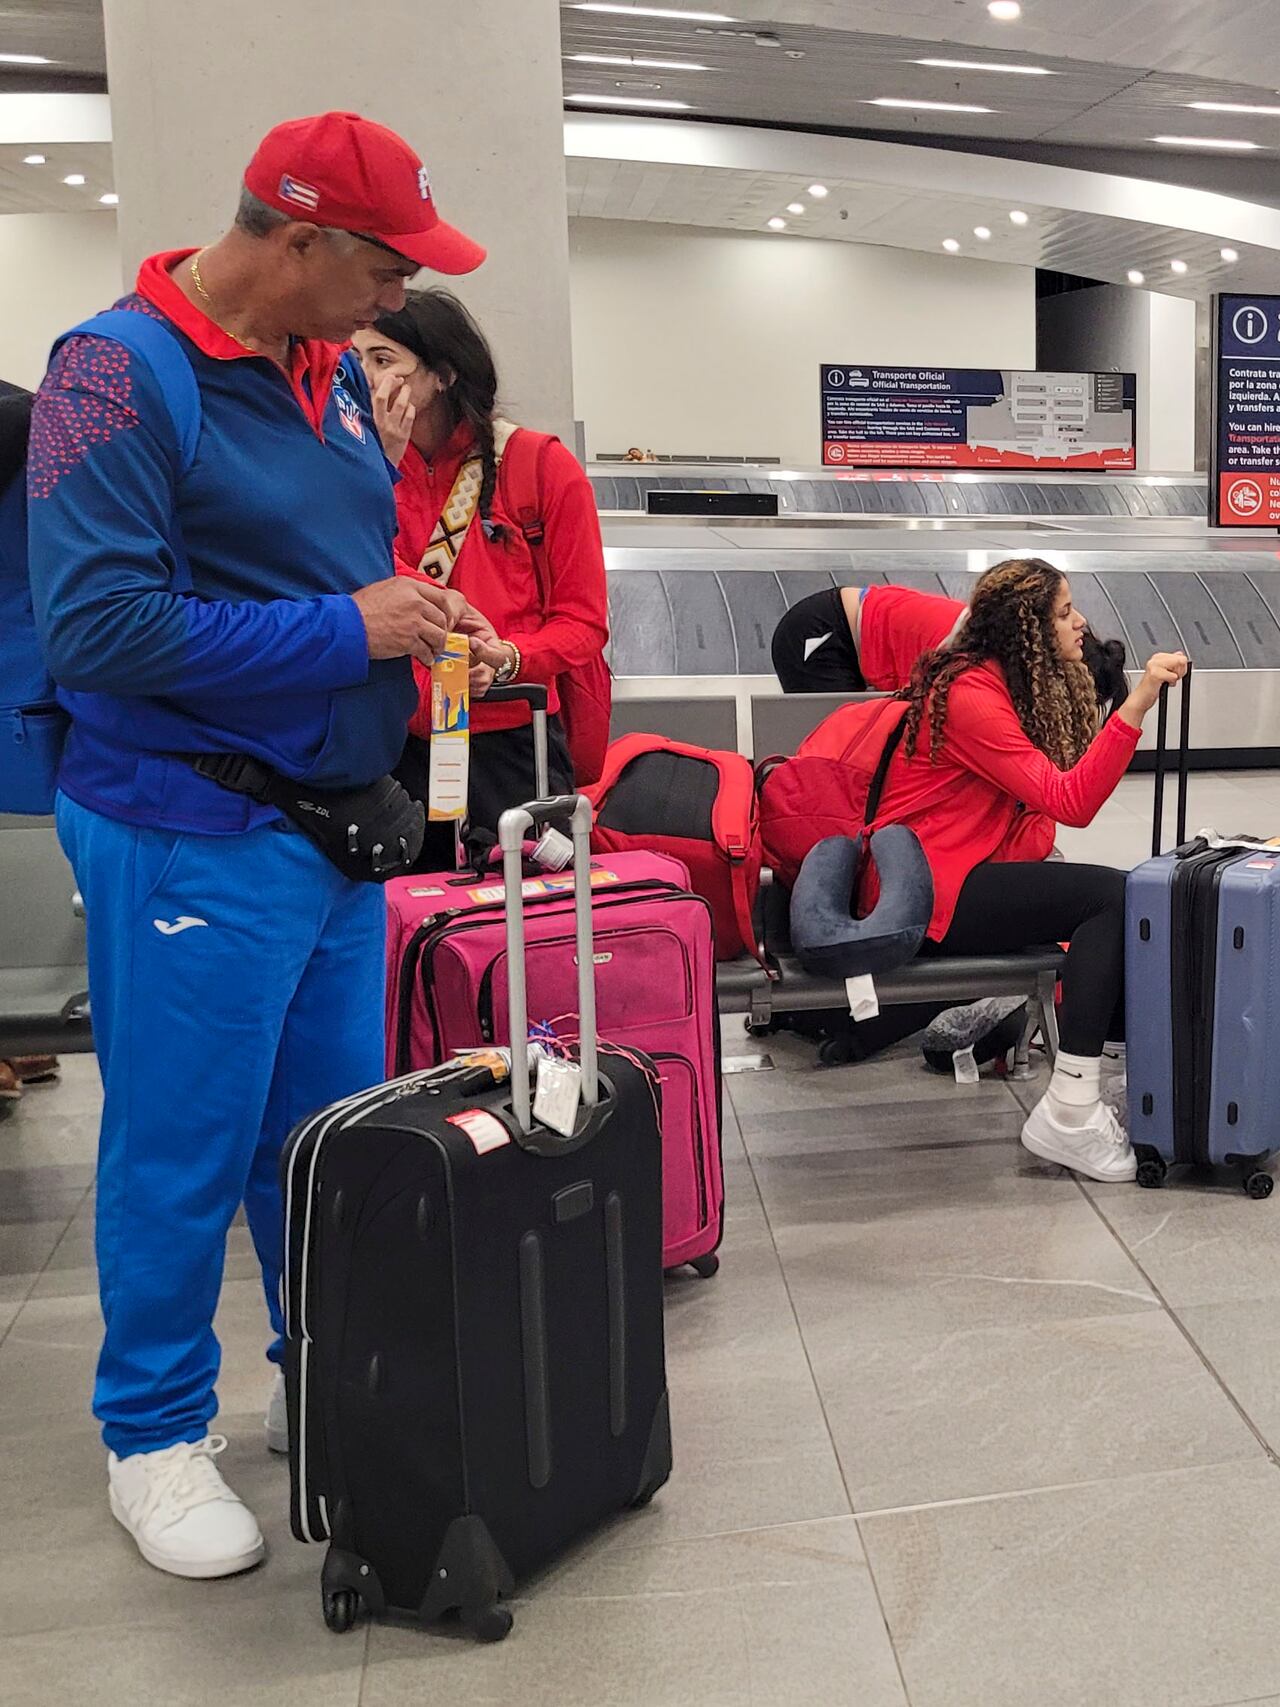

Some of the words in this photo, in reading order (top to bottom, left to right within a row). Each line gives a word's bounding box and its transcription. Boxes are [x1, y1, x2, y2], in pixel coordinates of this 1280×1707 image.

[872, 371, 917, 381] Transporte
[919, 372, 945, 381] Oficial
[1229, 368, 1266, 377] Contrata
[873, 381, 898, 389] Official
[899, 382, 951, 390] Transportation
[1229, 381, 1244, 390] por
[1246, 380, 1254, 389] la
[1229, 391, 1271, 402] izquierda.
[1228, 404, 1234, 412] y
[1236, 402, 1274, 412] transfers
[1228, 422, 1245, 430] You
[1264, 423, 1280, 431] hire
[1251, 445, 1270, 454] Take
[1239, 456, 1273, 465] transfer
